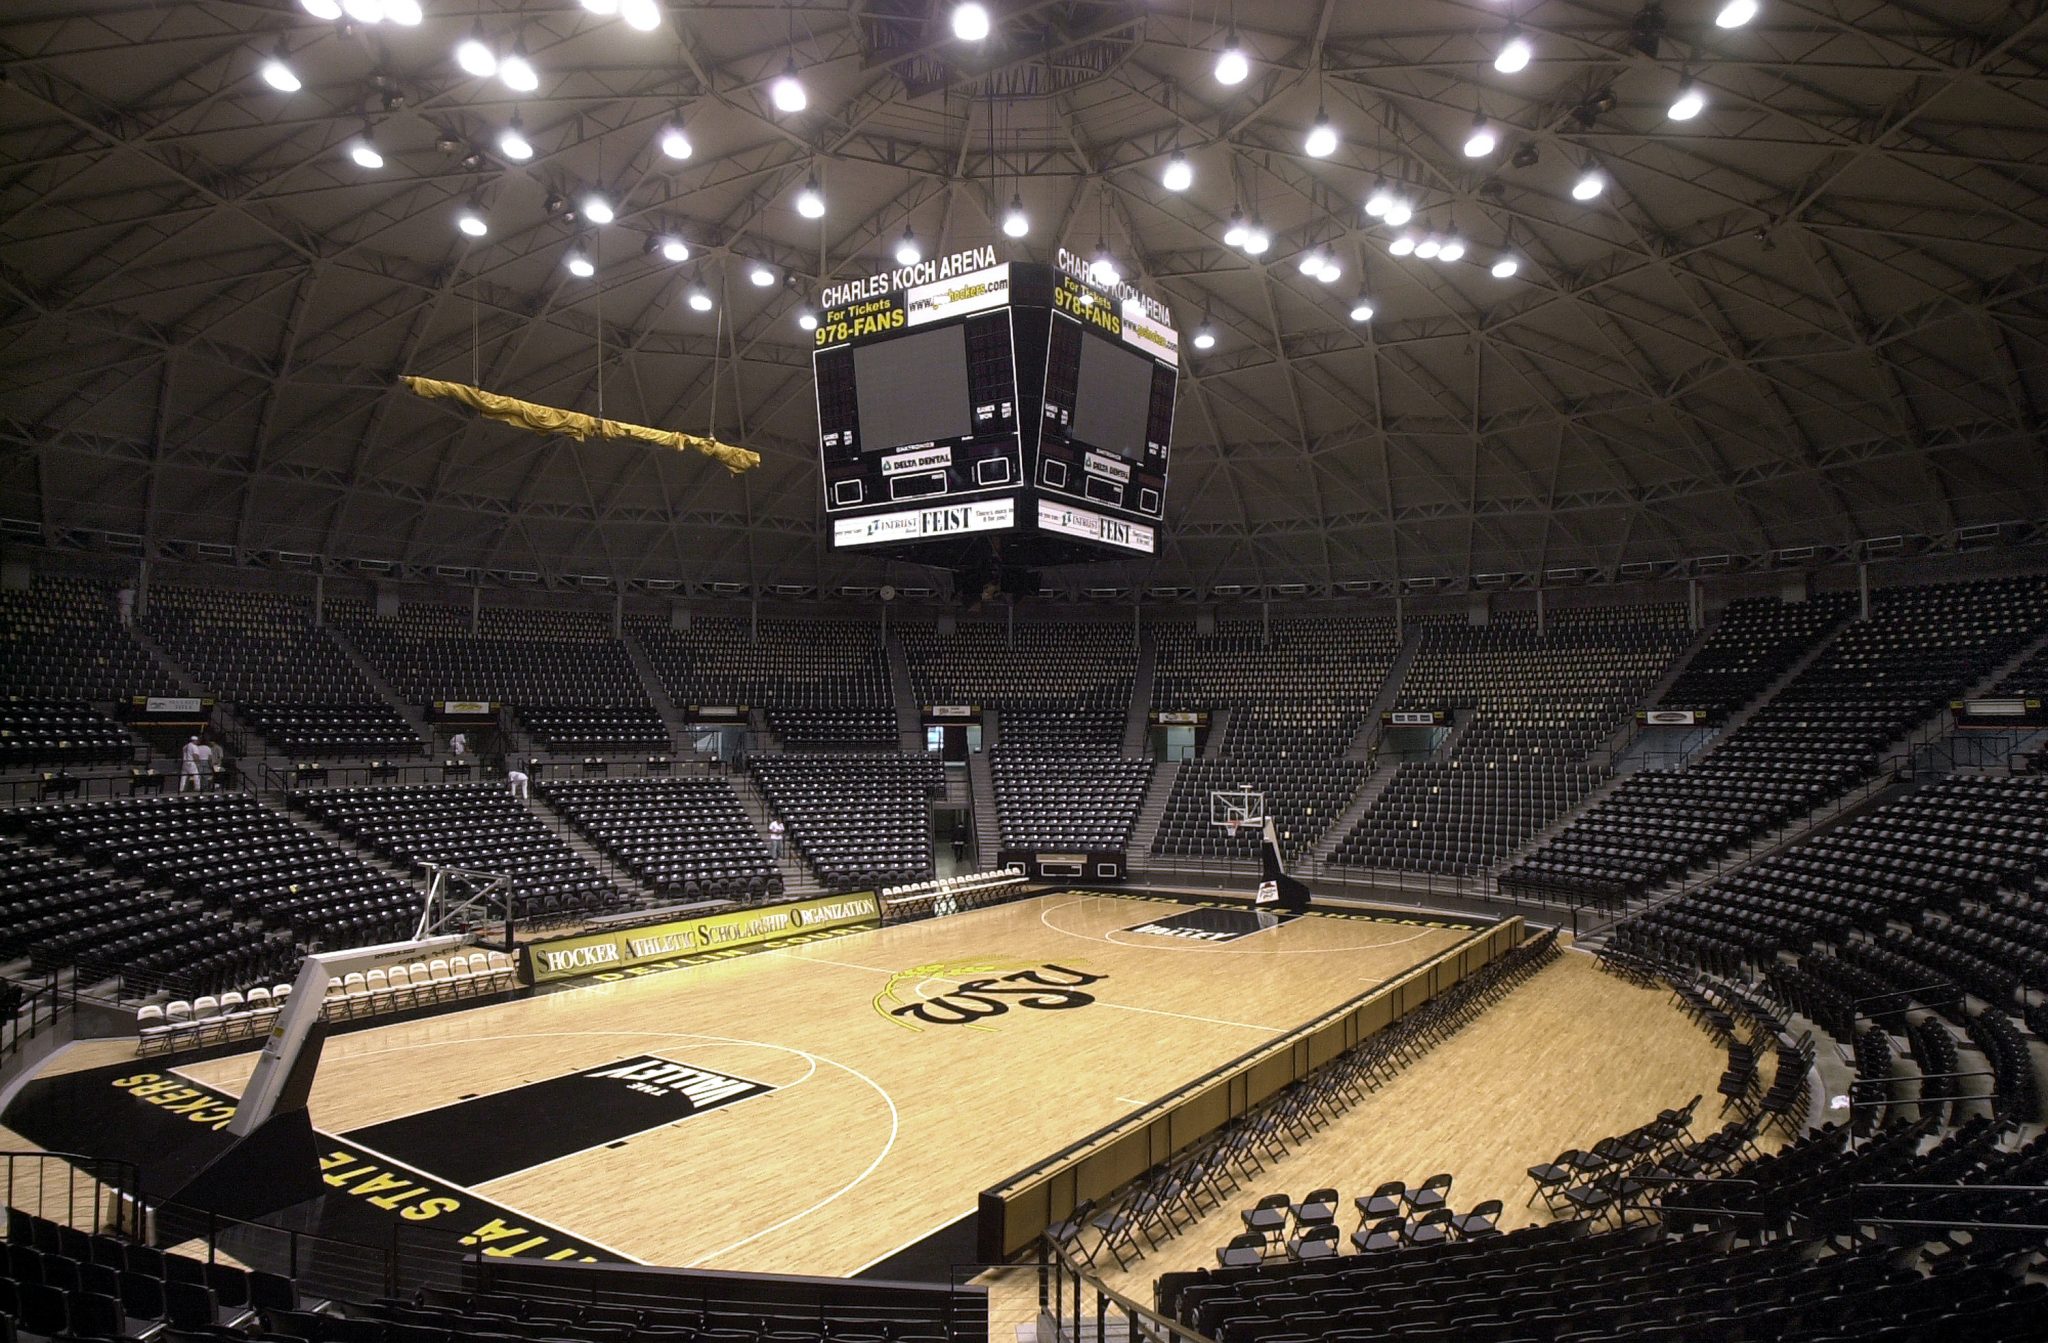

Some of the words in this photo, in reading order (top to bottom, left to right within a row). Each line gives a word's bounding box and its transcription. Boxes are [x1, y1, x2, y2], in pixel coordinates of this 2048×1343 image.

[822, 273, 889, 308] CHARLES
[893, 259, 936, 290] KOCH
[939, 244, 997, 279] ARENA
[1064, 276, 1079, 292] For
[827, 311, 845, 323] For
[848, 299, 891, 317] Tickets
[1055, 286, 1120, 334] 978-FANS
[815, 308, 904, 345] 978-FANS
[894, 460, 917, 470] DELTA
[918, 454, 950, 466] DENTAL
[921, 507, 972, 533] FEIST
[1100, 517, 1131, 544] FEIST
[536, 943, 620, 974] SHOCKER
[624, 931, 697, 960] ATHLETIC
[698, 913, 789, 946] SCHOLARSHIP
[790, 898, 875, 928] ORGANIZATION
[583, 1060, 756, 1108] VALLEY
